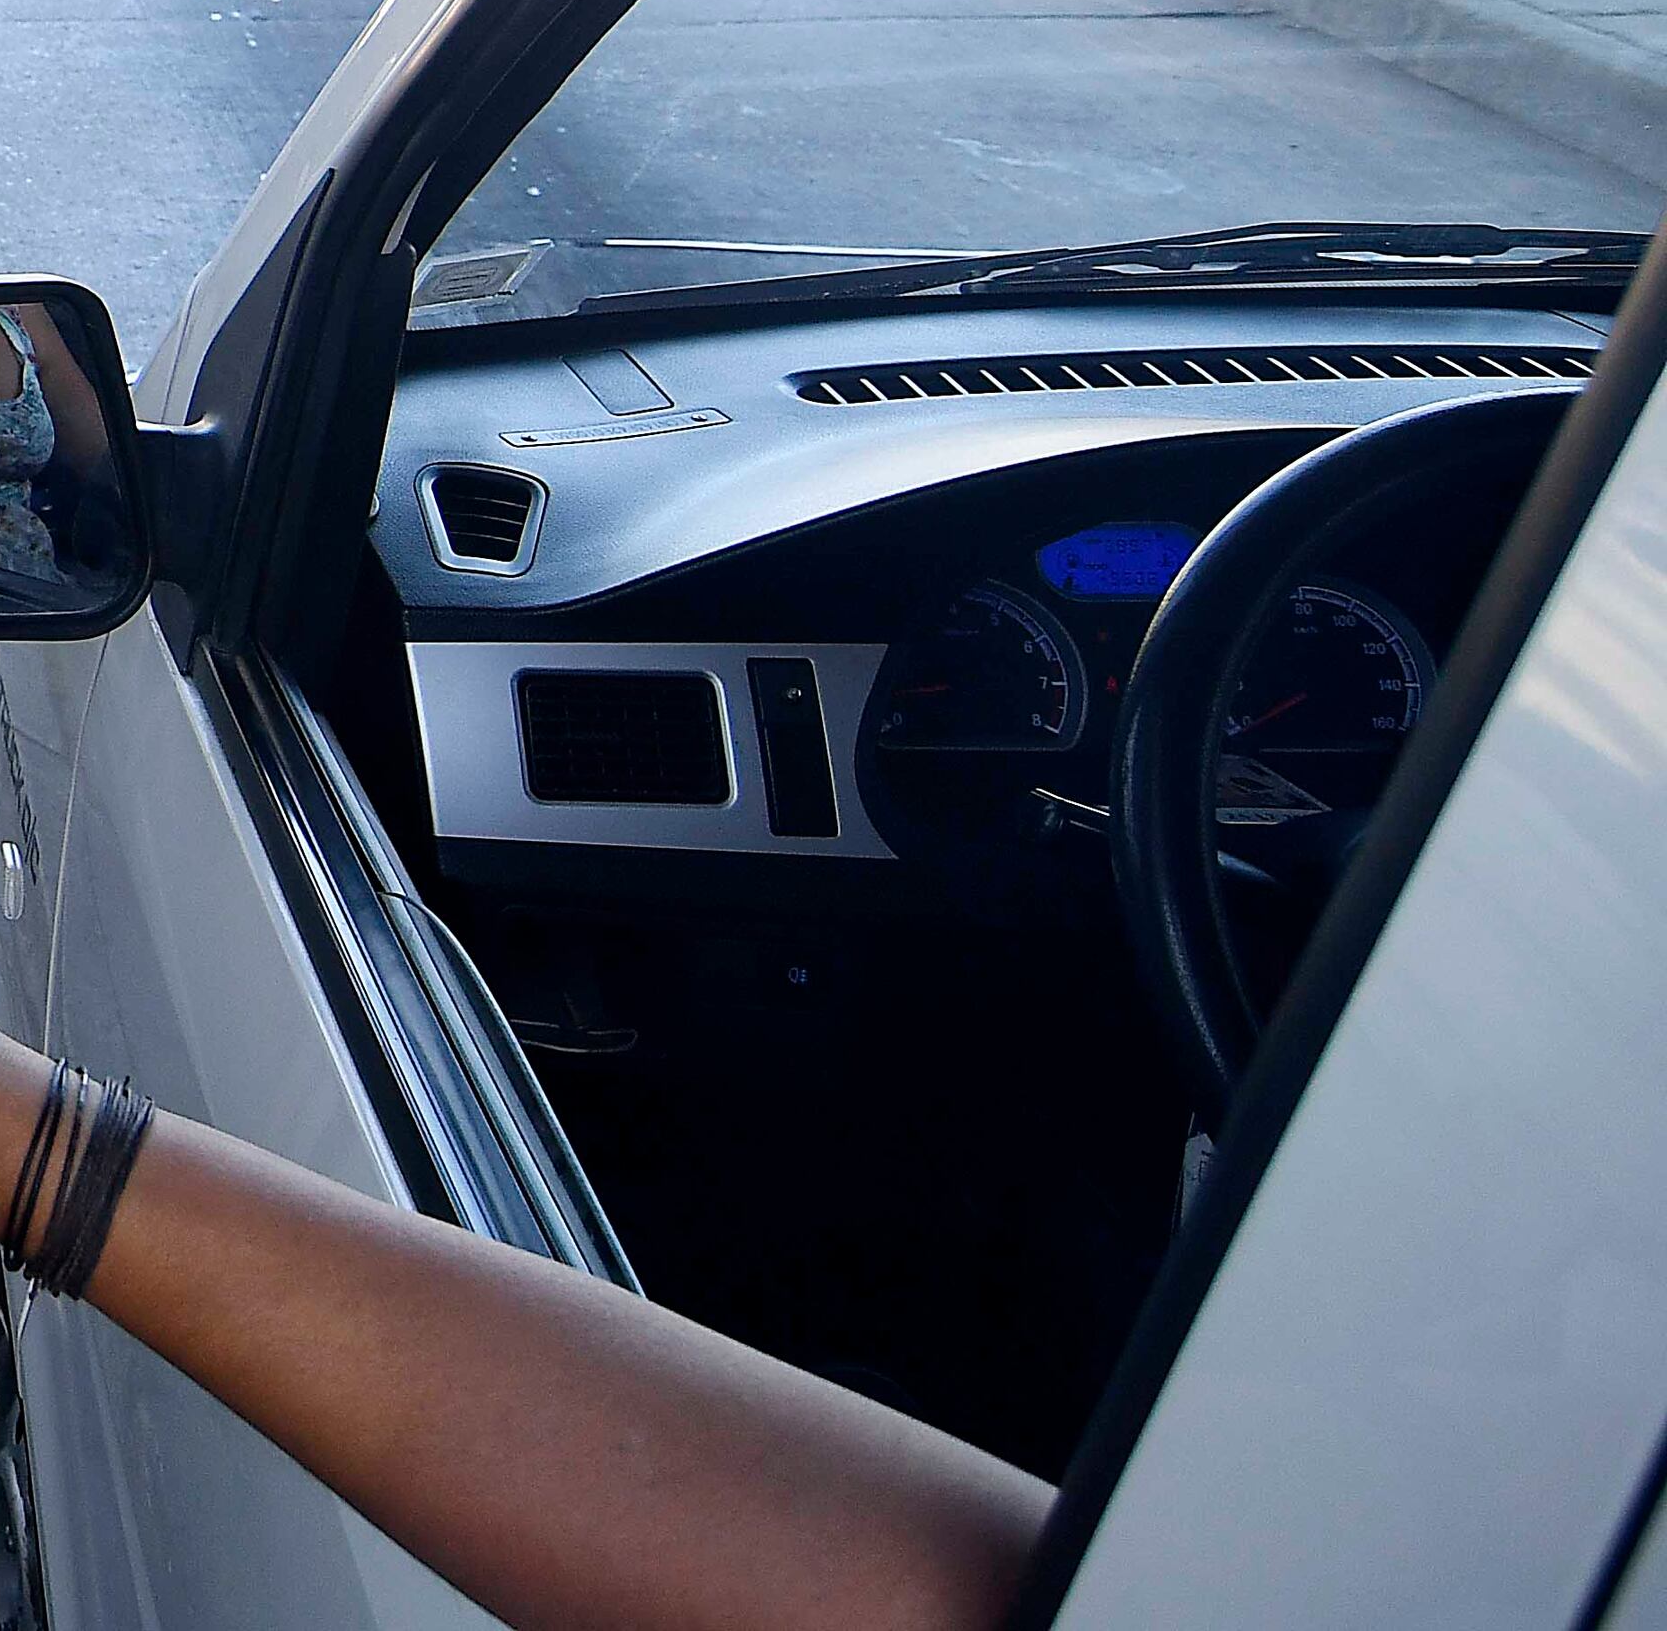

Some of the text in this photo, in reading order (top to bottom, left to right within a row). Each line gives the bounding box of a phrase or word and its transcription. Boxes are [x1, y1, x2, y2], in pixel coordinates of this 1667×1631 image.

[1362, 642, 1387, 656] 120
[1038, 676, 1049, 690] 7
[1378, 678, 1402, 692] 140
[1031, 712, 1042, 727] 8
